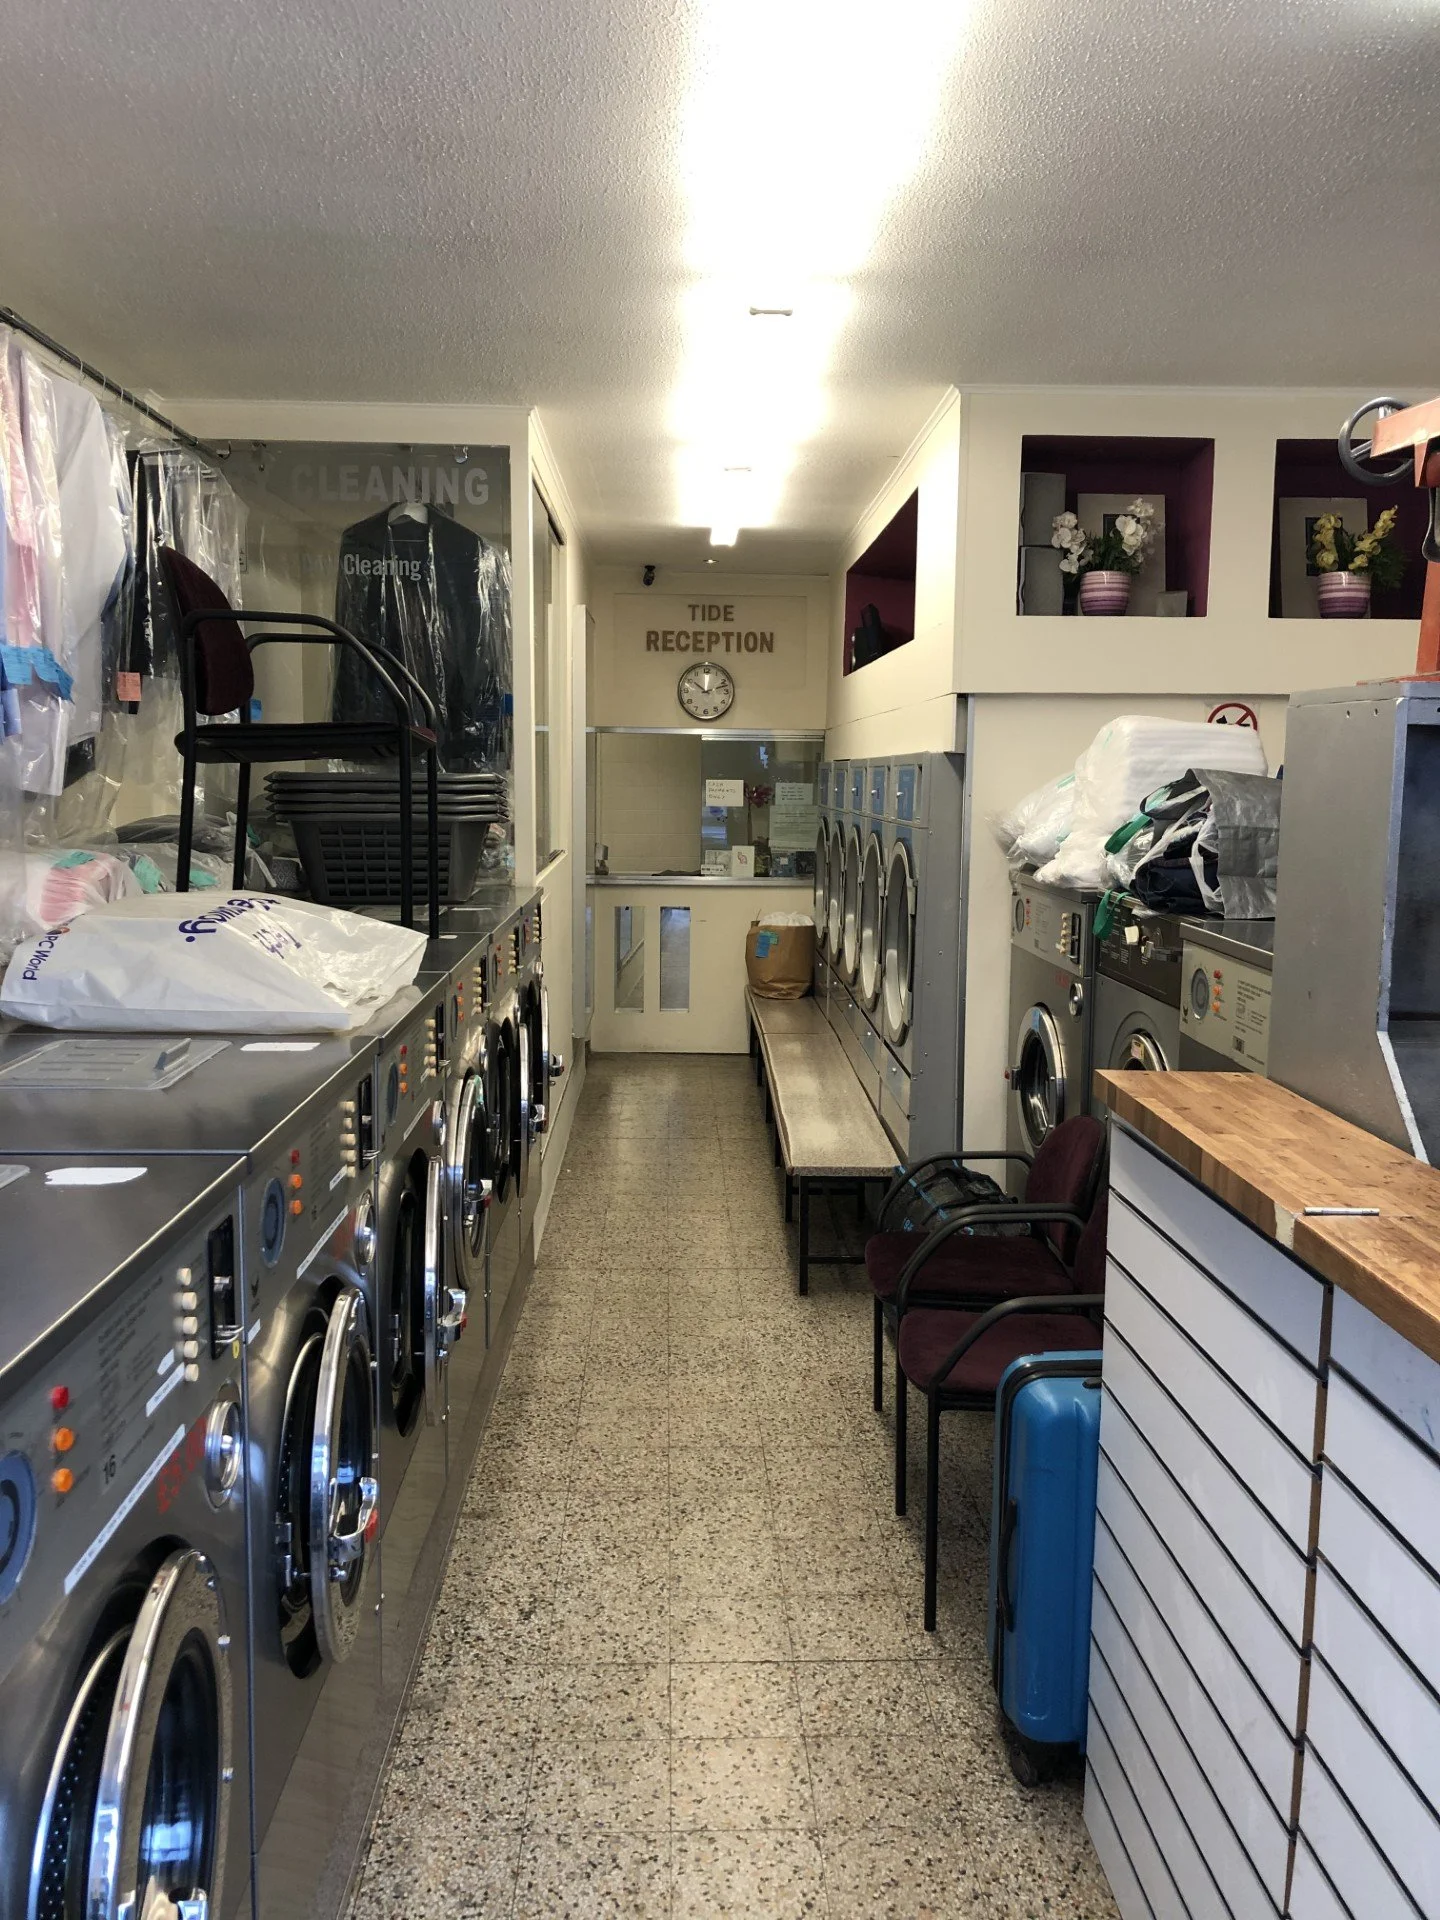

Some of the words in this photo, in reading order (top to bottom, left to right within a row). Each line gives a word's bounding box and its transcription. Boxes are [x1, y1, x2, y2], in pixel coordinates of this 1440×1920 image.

[291, 464, 490, 506] CLEANING
[343, 554, 422, 581] Cleaning
[687, 603, 735, 622] TIDE
[645, 630, 775, 653] RECEPTION
[38, 935, 60, 949] PC
[22, 950, 52, 981] World
[102, 1454, 117, 1485] 16
